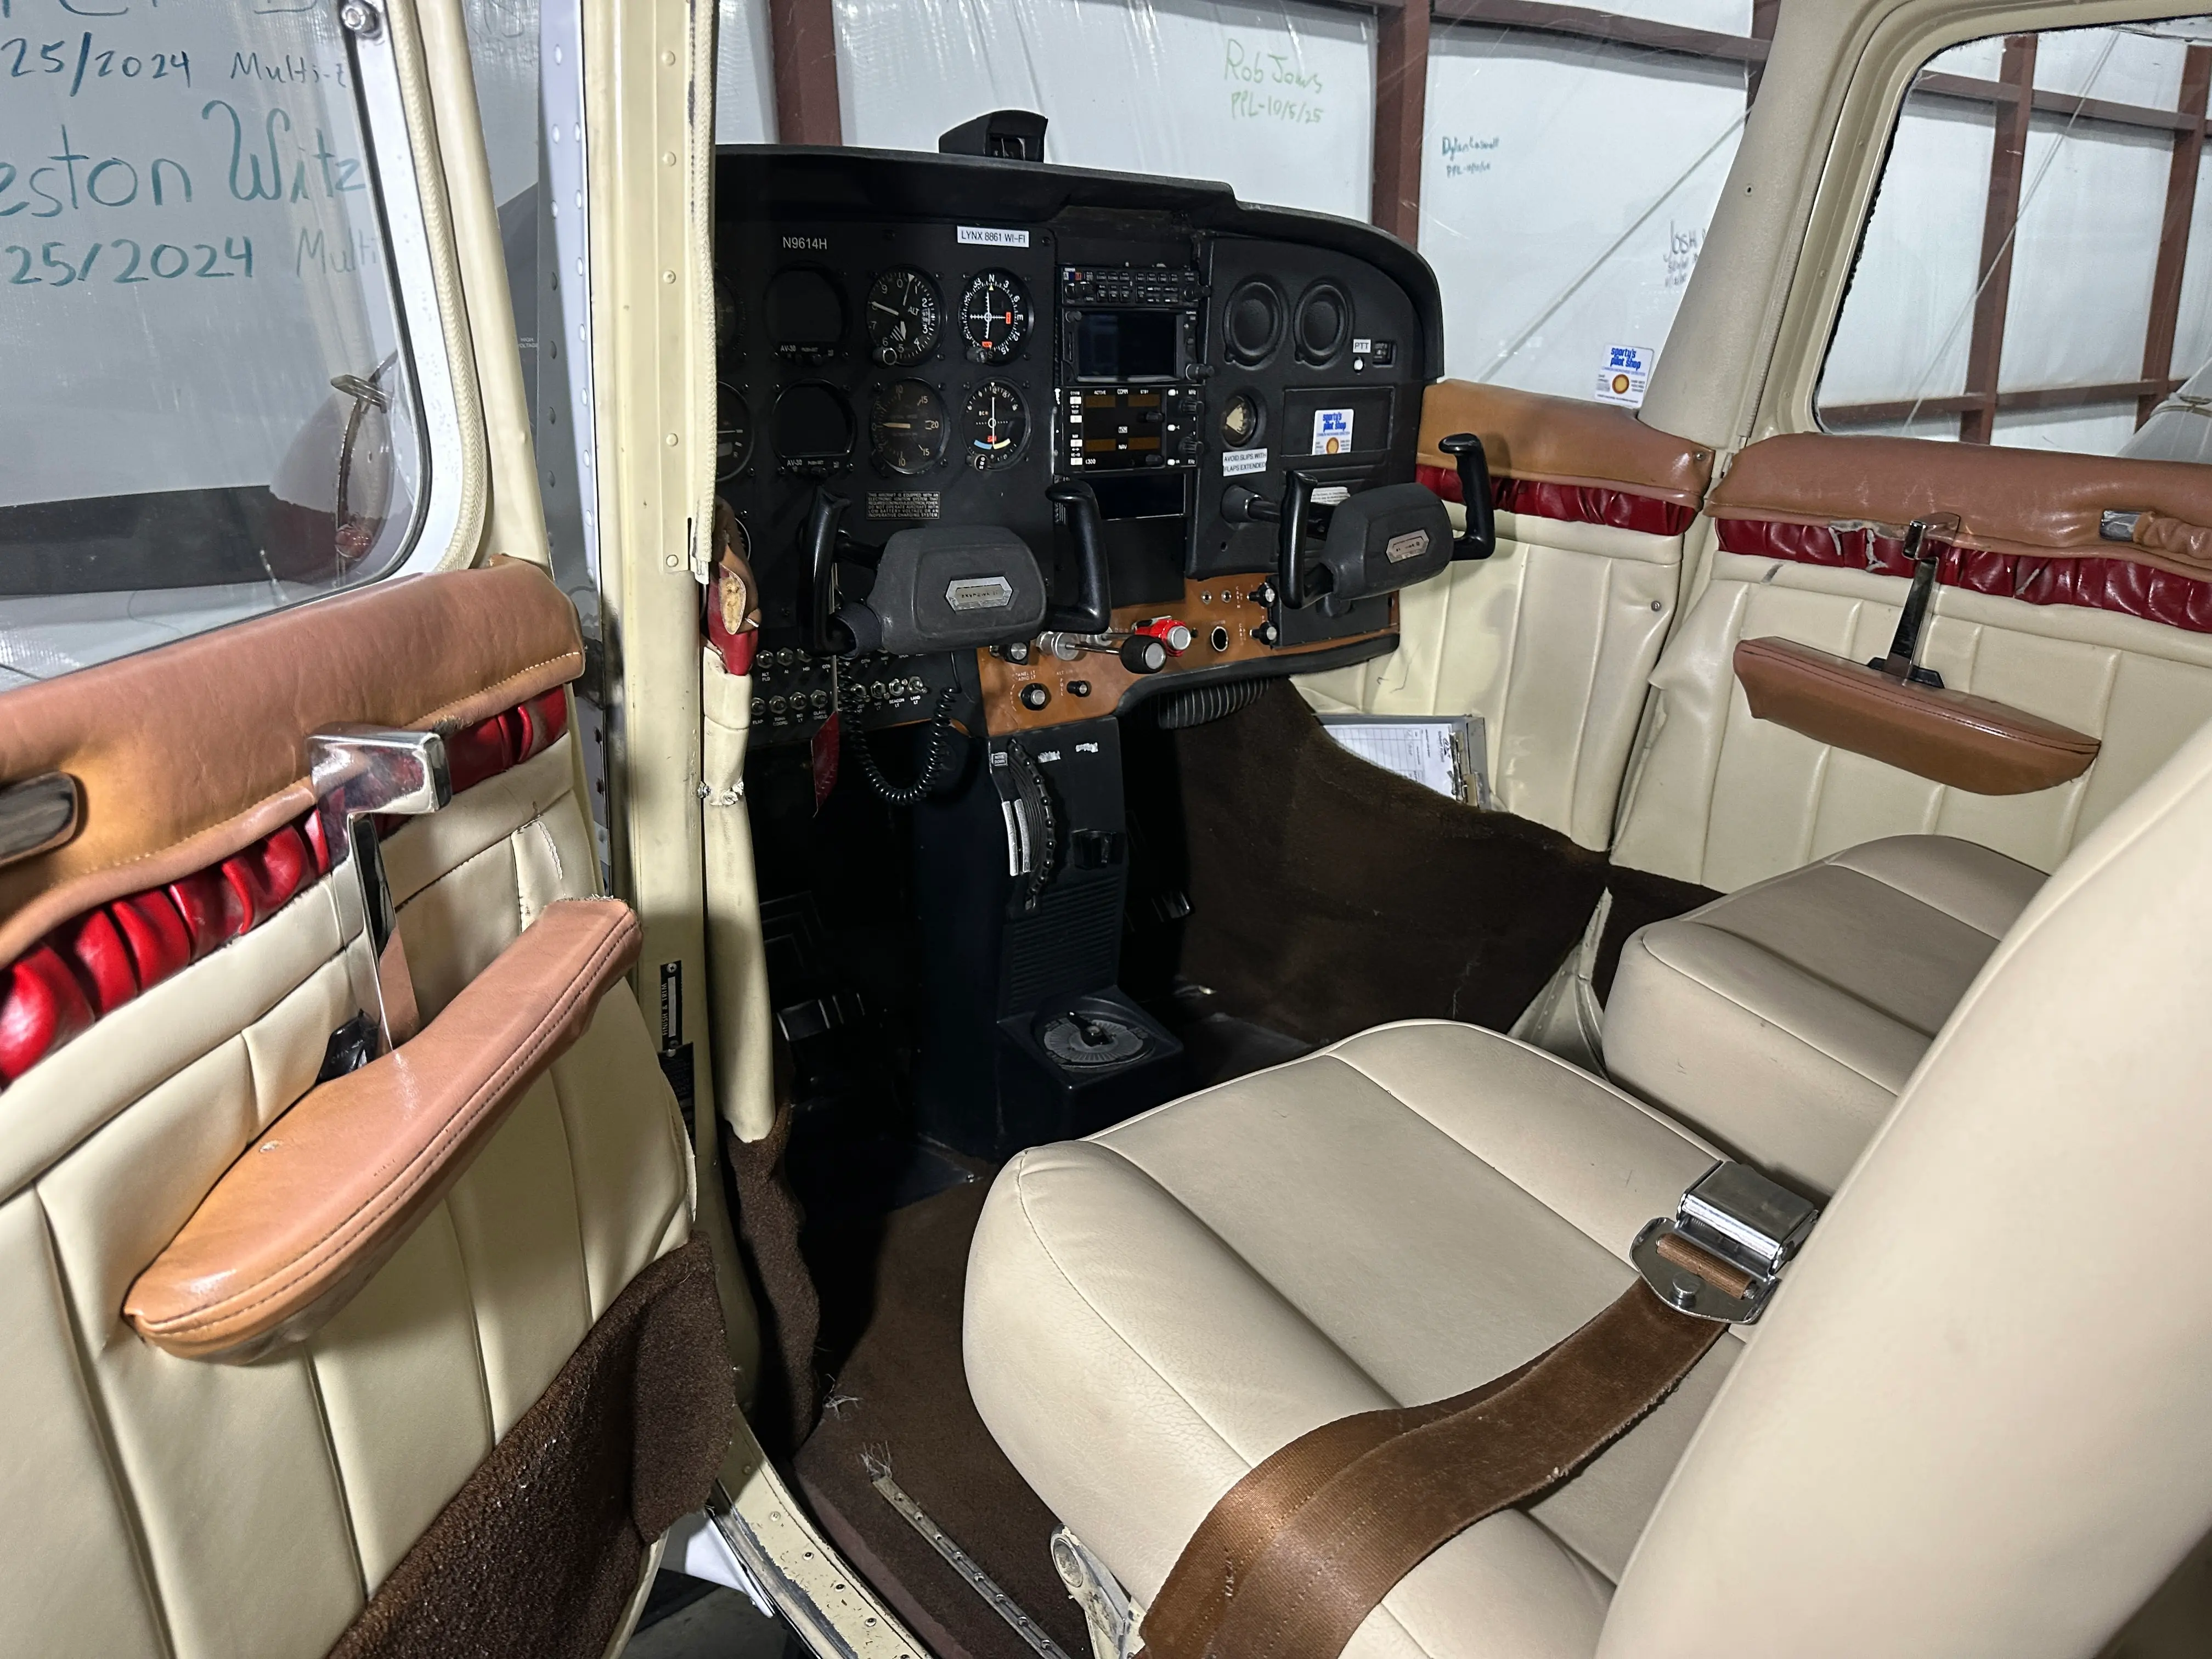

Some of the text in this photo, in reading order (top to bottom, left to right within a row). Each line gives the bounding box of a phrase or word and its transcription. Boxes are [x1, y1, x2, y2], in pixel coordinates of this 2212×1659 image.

[1224, 38, 1264, 83] Rob
[961, 230, 1026, 244] LYNX 8861 WI-FI
[782, 236, 828, 250] N9614H
[5, 234, 253, 286] 25/2024
[989, 274, 995, 283] N
[1003, 280, 1009, 288] 3
[922, 298, 928, 307] 2
[908, 306, 919, 316] ALT
[922, 324, 928, 334] 3
[1012, 332, 1021, 341] 12
[1001, 345, 1010, 356] 15
[1354, 342, 1369, 351] PTT
[988, 351, 993, 359] S
[1611, 347, 1637, 360] sporty's
[1610, 357, 1624, 367] pilot
[921, 396, 928, 404] 15
[1323, 412, 1342, 423] sporty's
[930, 420, 939, 429] 20
[923, 448, 930, 456] 15
[898, 458, 906, 466] 10
[1224, 454, 1239, 462] AVOID
[1224, 462, 1266, 472] FLAPS EXTENDED
